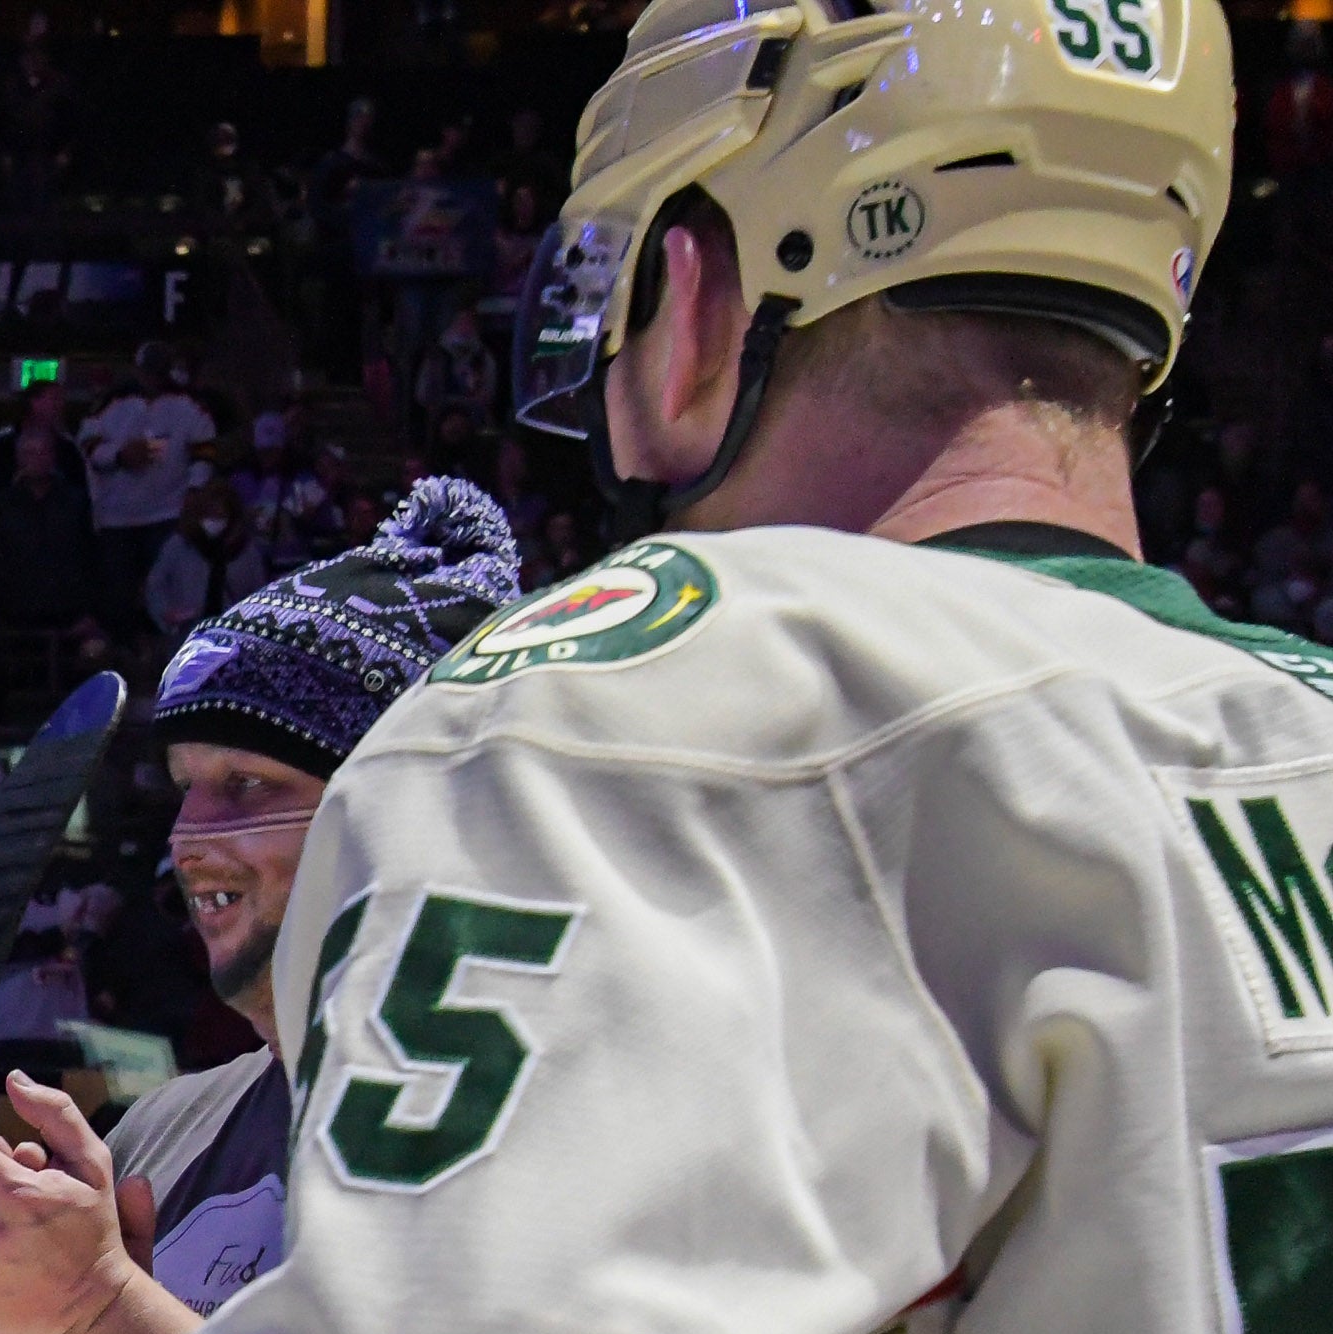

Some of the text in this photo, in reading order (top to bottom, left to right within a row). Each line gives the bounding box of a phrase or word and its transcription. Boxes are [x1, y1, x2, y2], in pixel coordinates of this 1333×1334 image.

[858, 196, 910, 242] TK
[162, 269, 190, 324] F
[1185, 796, 1333, 1018] M
